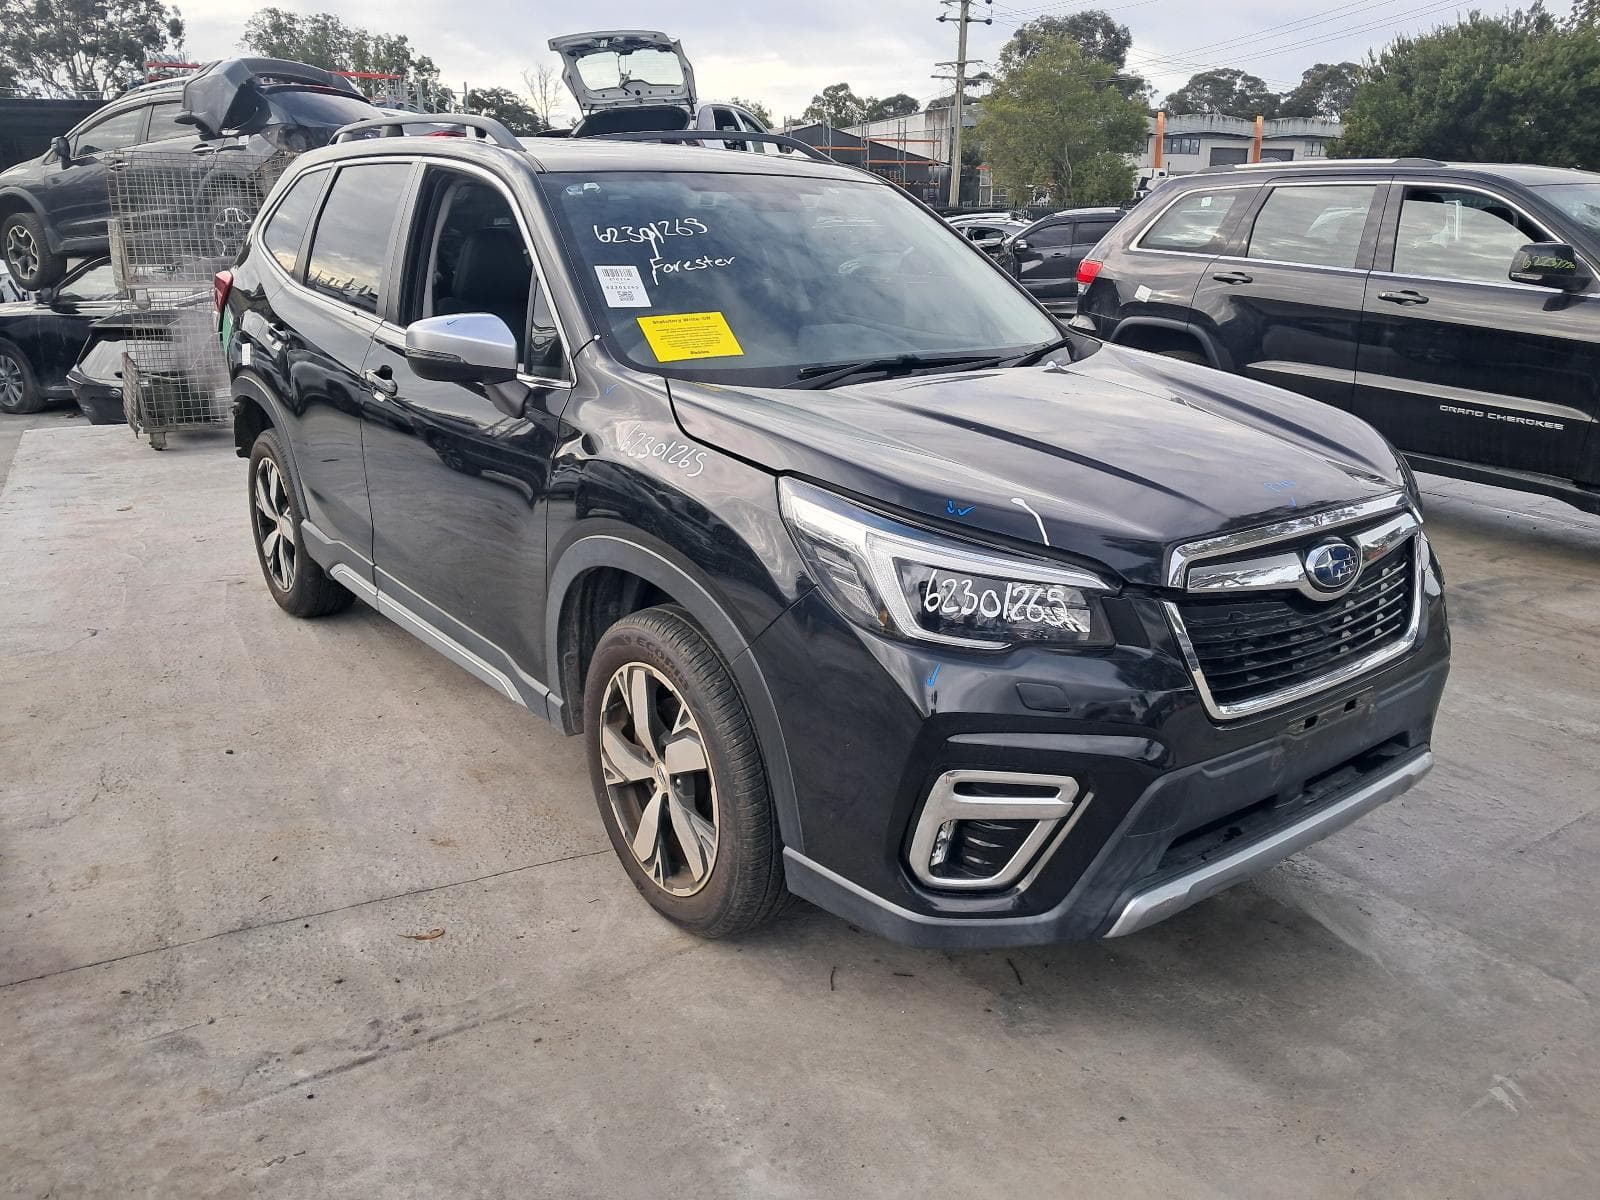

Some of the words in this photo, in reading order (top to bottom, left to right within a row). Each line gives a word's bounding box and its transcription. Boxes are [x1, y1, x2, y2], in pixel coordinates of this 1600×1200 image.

[650, 254, 736, 286] Forester
[1439, 404, 1484, 418] GRAND
[1487, 412, 1565, 431] CHEROKEE
[619, 423, 708, 477] 62301265
[924, 568, 1069, 626] 62301265
